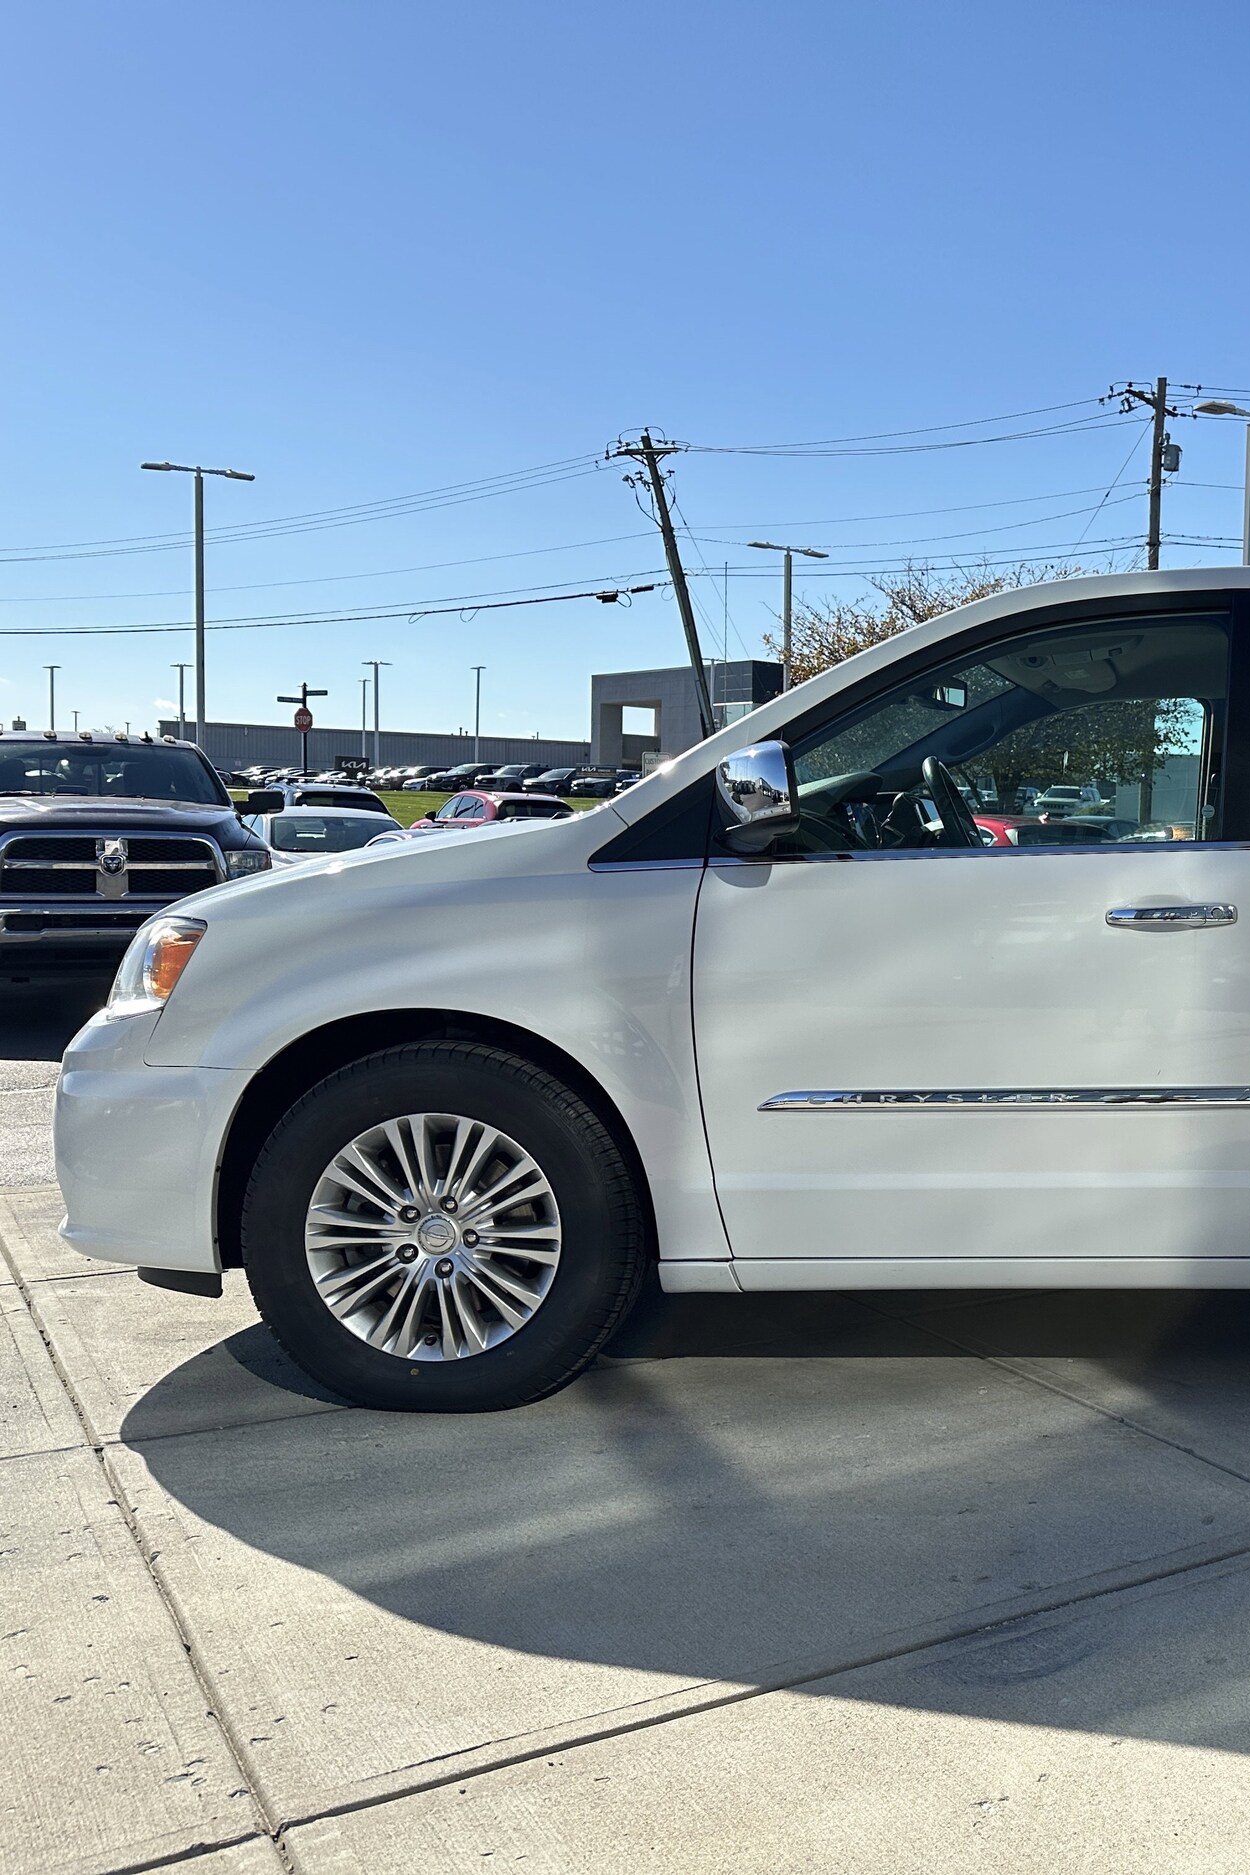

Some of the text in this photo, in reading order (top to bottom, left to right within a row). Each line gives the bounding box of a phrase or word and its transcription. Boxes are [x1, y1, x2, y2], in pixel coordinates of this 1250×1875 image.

[295, 715, 311, 725] STOP
[341, 760, 367, 769] KIA
[807, 1093, 1071, 1105] CHRYSLER
